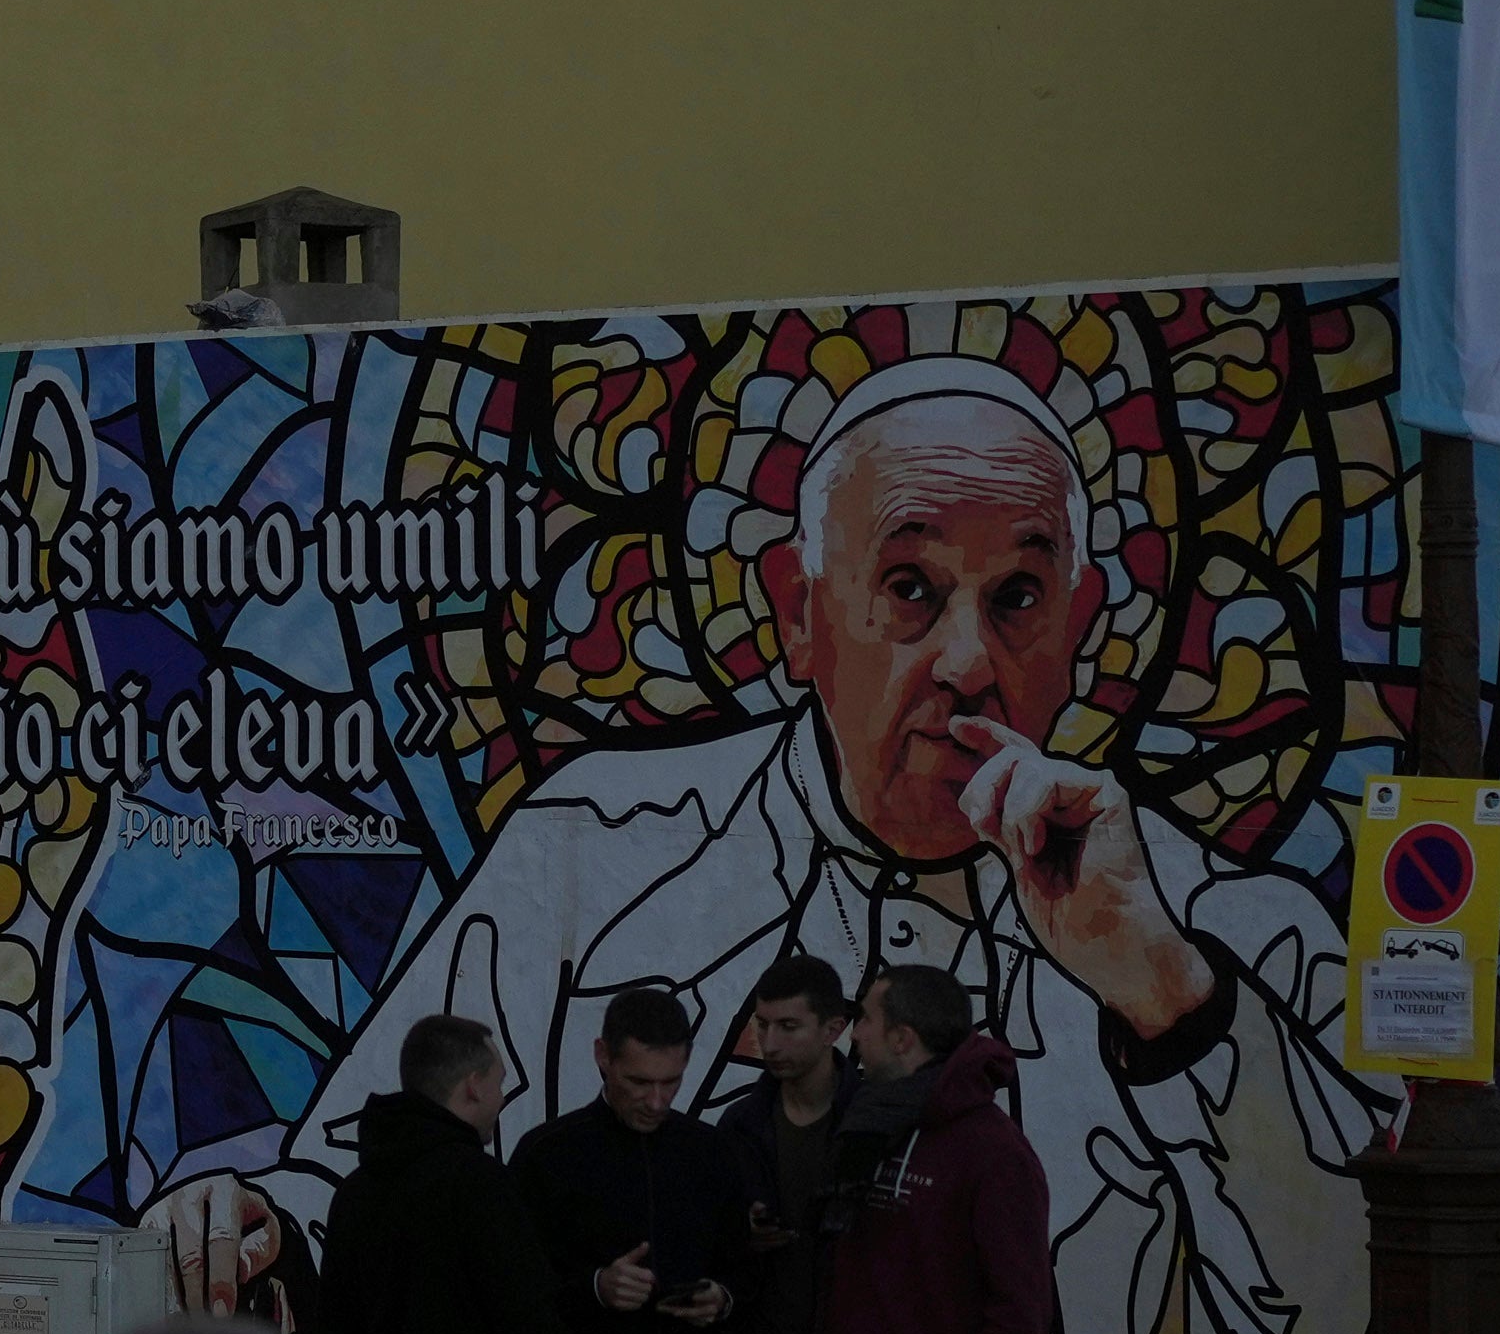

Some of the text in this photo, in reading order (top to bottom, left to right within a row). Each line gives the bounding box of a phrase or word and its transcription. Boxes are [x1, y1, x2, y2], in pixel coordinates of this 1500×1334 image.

[58, 497, 296, 603] siamo
[322, 471, 542, 593] umili
[80, 677, 147, 786] ci
[116, 797, 398, 859] Papa Francesco
[1373, 989, 1466, 1001] STATIONNEMENT
[1394, 1004, 1446, 1015] INTERDIT
